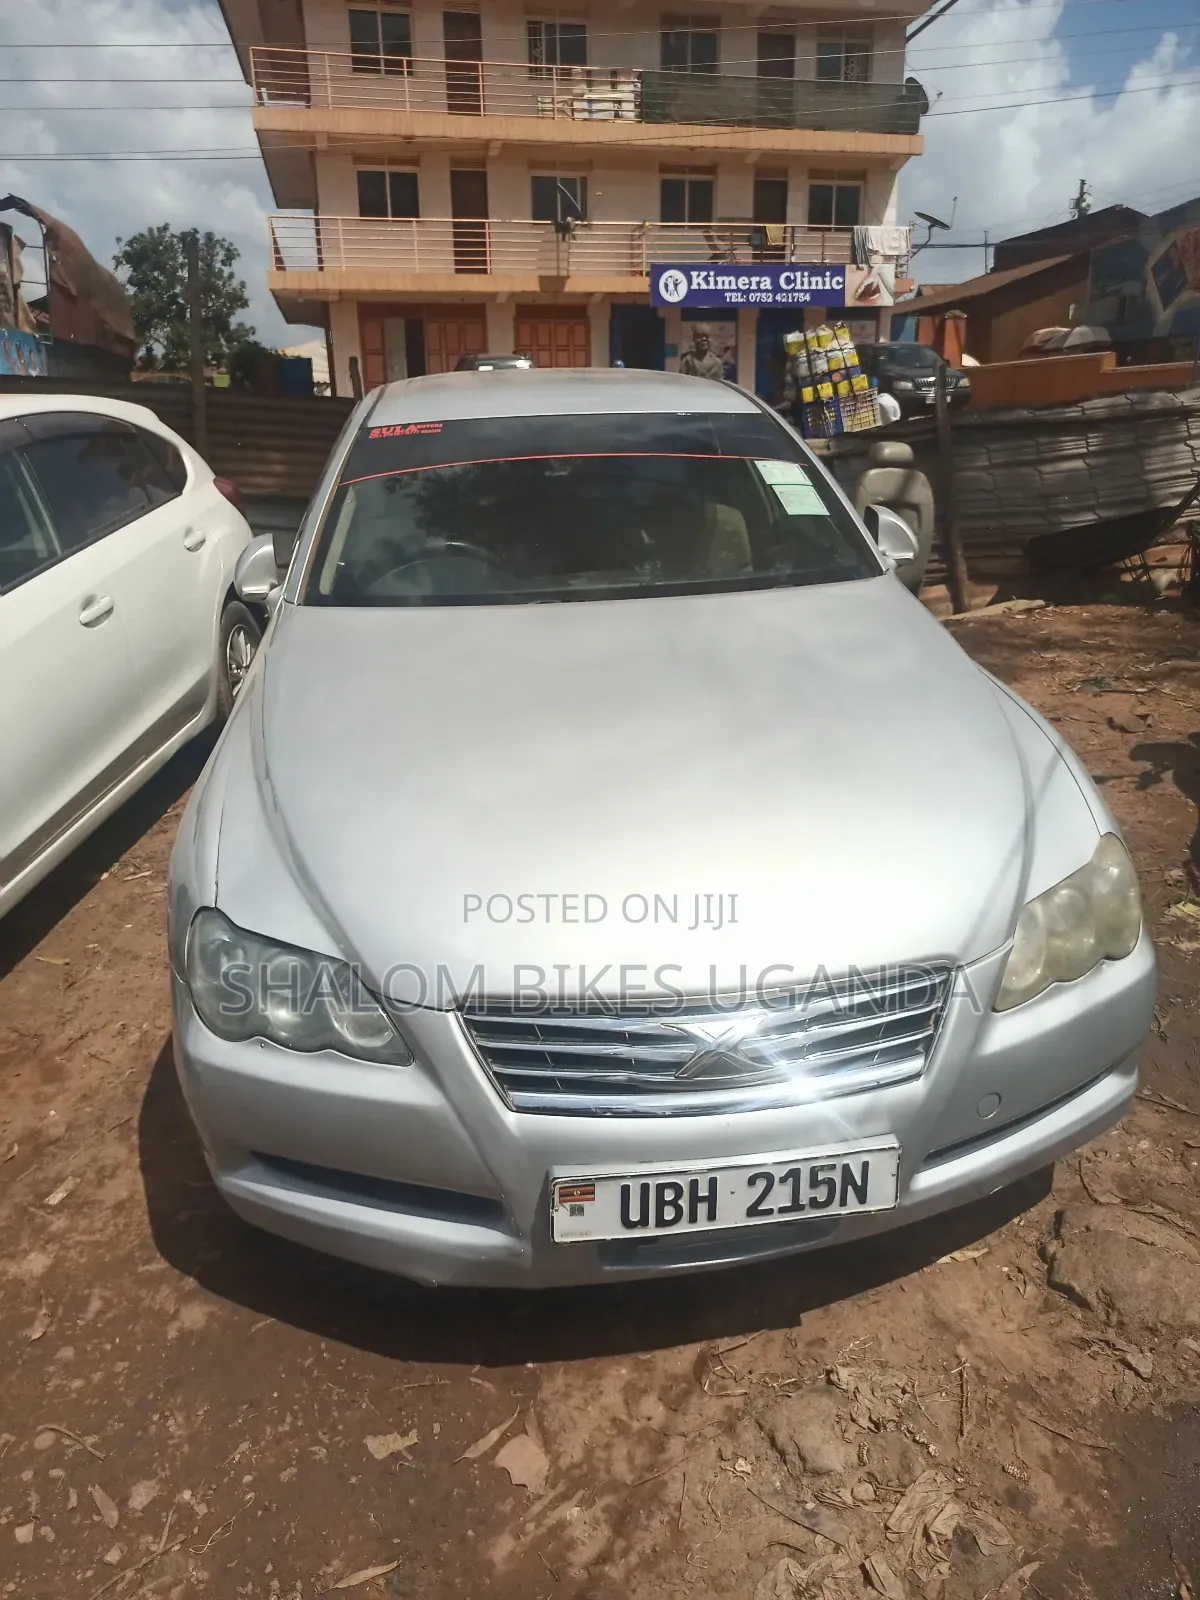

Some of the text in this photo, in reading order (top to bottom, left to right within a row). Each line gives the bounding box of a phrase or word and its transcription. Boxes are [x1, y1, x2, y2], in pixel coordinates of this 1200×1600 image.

[690, 270, 844, 290] Kimera Clinic
[724, 292, 746, 302] TEL:
[749, 292, 774, 302] 0752
[619, 1160, 870, 1229] UBH 215N
